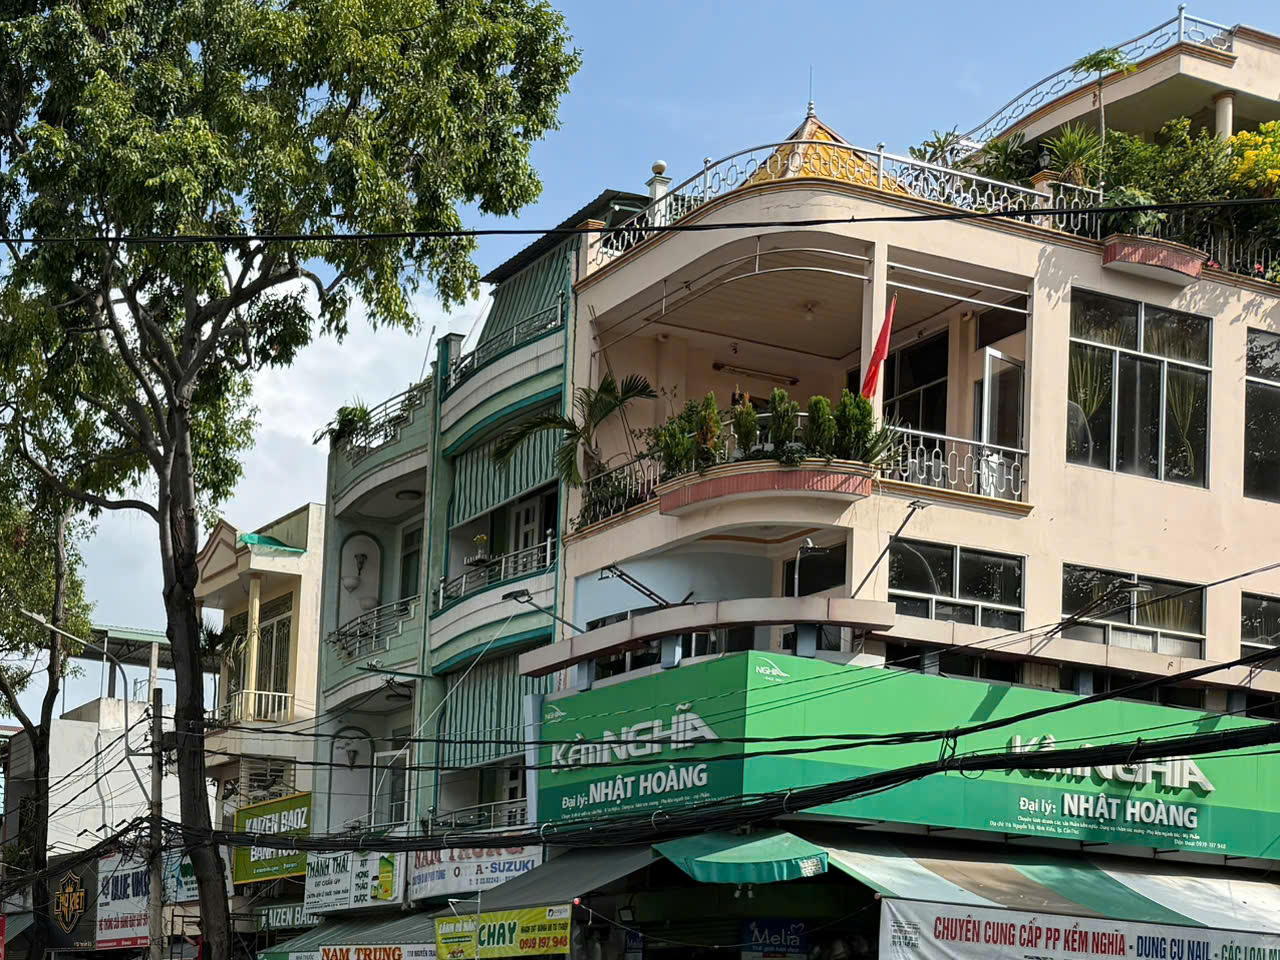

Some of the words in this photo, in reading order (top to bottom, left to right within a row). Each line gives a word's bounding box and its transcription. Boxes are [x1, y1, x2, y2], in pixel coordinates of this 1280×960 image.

[562, 796, 576, 811] Đại
[589, 775, 637, 804] NHẬT
[639, 763, 709, 797] HOÀNG
[245, 813, 281, 835] KAIZEN
[281, 806, 309, 833] BAOZ
[1019, 797, 1039, 812] Đại
[1041, 798, 1057, 814] lý:
[1063, 792, 1120, 823] NHẬT
[1125, 799, 1198, 829] HOÀNG
[490, 859, 535, 873] SUZUKI
[478, 920, 518, 947] CHAY
[751, 928, 801, 946] Melia
[934, 914, 981, 943] CHUYÊN
[984, 920, 1016, 945] CUNG
[1019, 917, 1042, 948] CẤP
[1045, 927, 1061, 950] PP
[1091, 929, 1126, 956] NGHĨA
